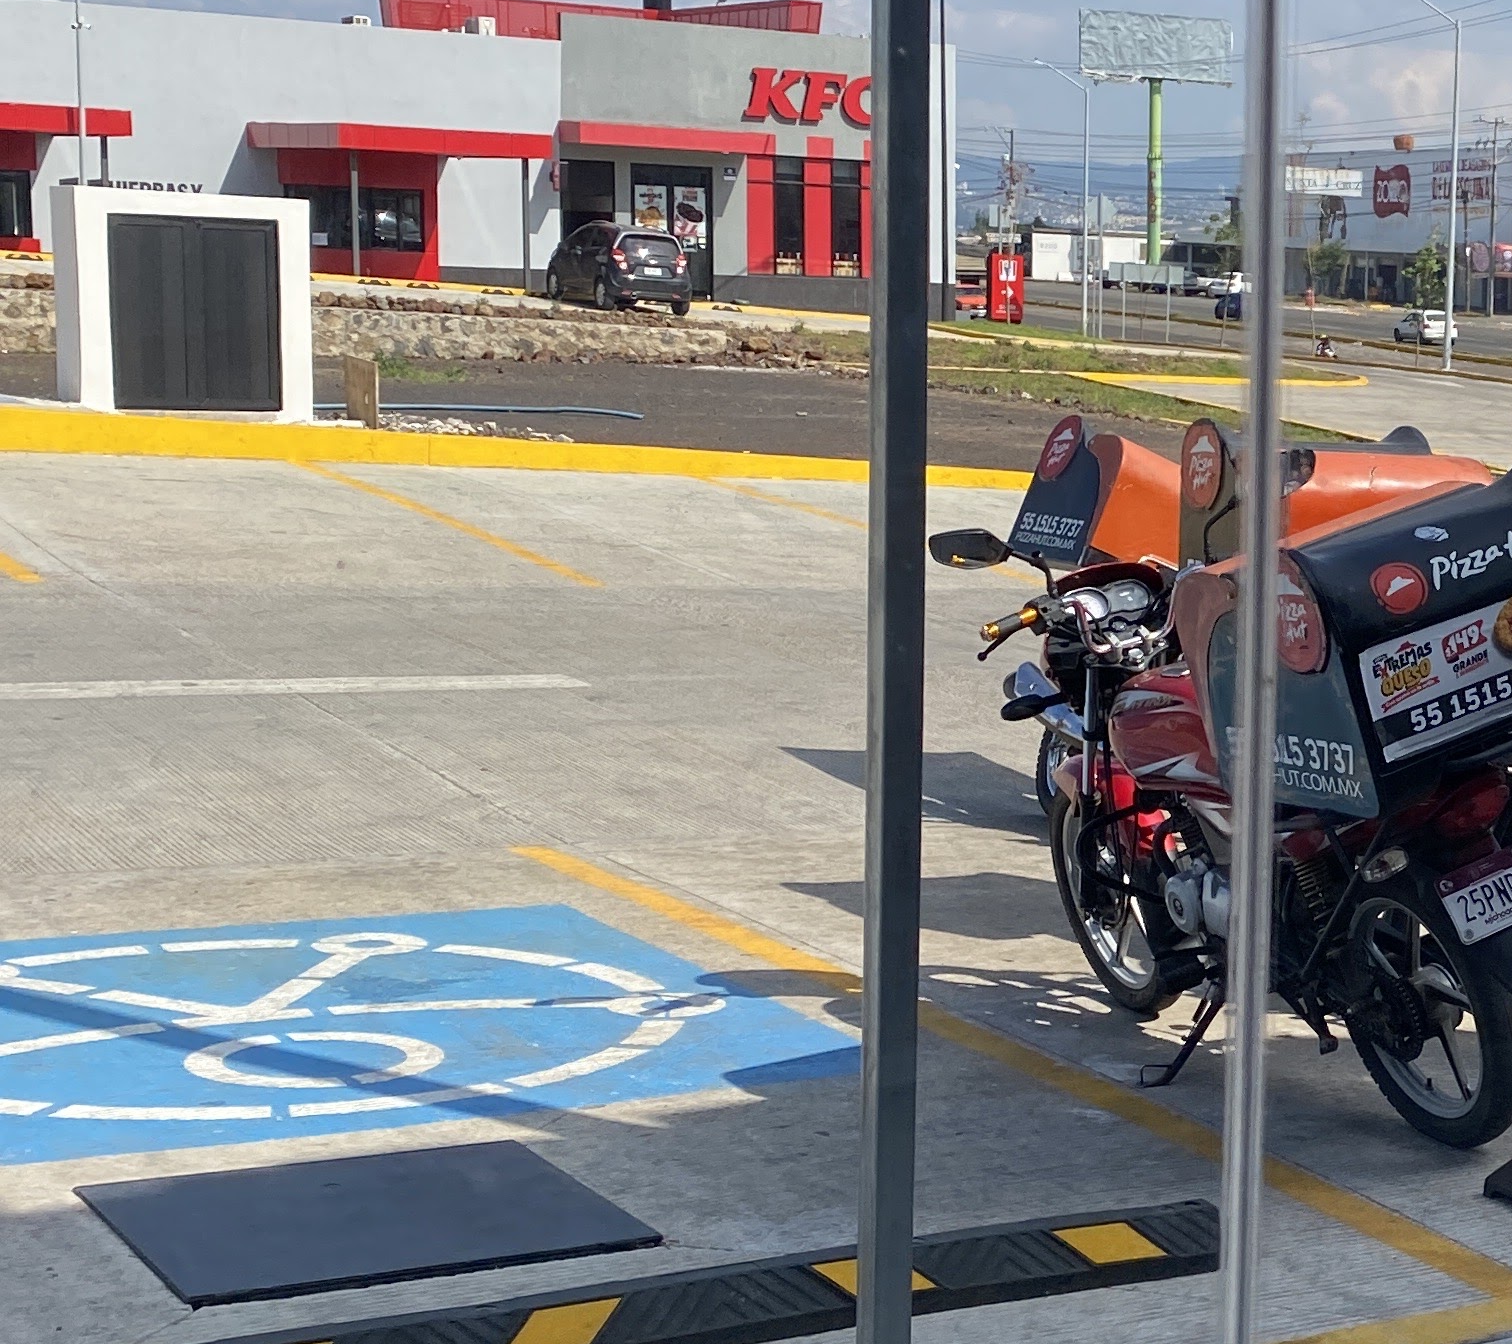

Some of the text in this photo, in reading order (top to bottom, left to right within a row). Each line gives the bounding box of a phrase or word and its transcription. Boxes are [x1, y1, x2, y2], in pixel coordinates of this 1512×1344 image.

[1188, 454, 1214, 477] Pizza
[1020, 512, 1085, 538] 55 1515 3737
[1429, 551, 1504, 591] Pizza
[1279, 596, 1307, 622] izza
[1372, 641, 1433, 679] EXTREMAS
[1380, 657, 1432, 697] QUESO
[1452, 648, 1488, 673] GRANDE
[1410, 704, 1443, 732] 55
[1450, 676, 1512, 719] 1515
[1304, 738, 1354, 775] 3737
